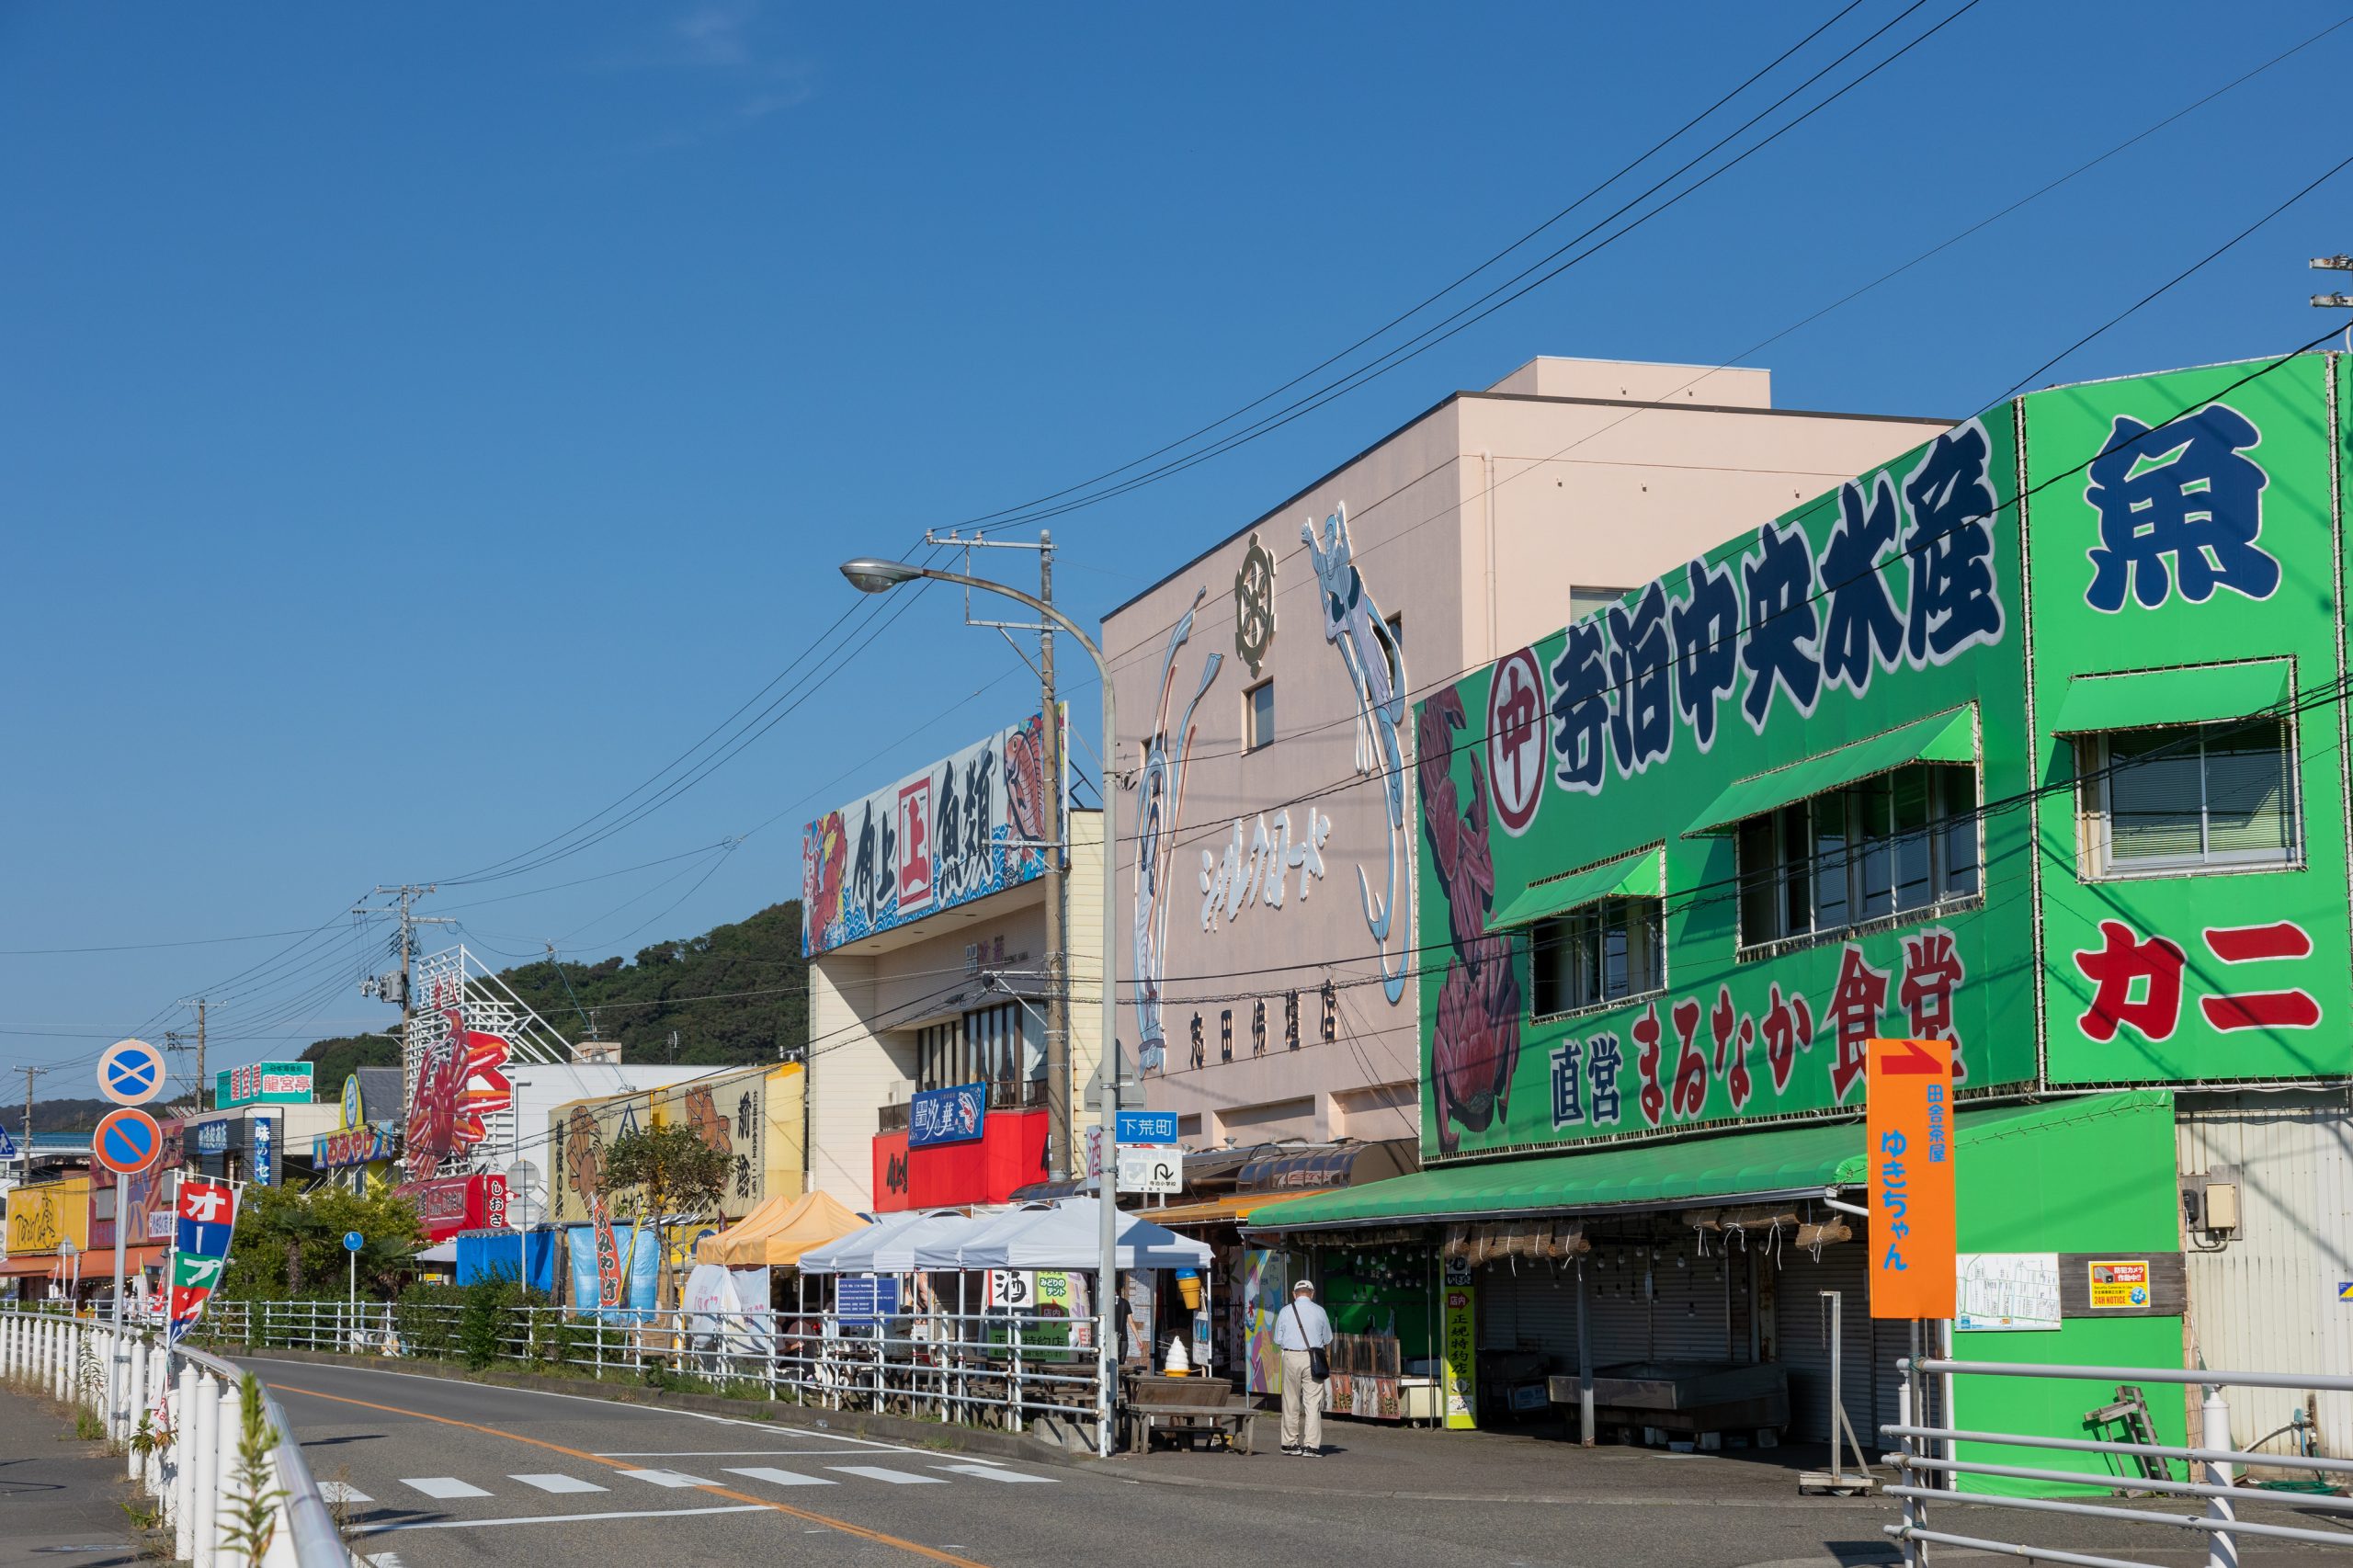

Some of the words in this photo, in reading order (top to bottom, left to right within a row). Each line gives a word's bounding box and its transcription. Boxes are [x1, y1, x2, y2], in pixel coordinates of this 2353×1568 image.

[2085, 402, 2281, 613] 魚
[1550, 418, 2006, 795] 寺泊中央水産
[2075, 921, 2322, 1044] カニ
[1550, 1033, 1623, 1131] 直営
[1632, 928, 1965, 1129] まるなか食堂
[263, 1074, 312, 1092] 龍宮亭
[1120, 1119, 1173, 1137] 下荒町
[1927, 1084, 1947, 1163] 田舎茶屋
[255, 1125, 270, 1186] 味のセ
[1881, 1130, 1910, 1272] ゆきちゃん
[597, 1201, 618, 1301] おみやげ
[1040, 1278, 1065, 1287] みどりの
[1043, 1308, 1061, 1317] 店内
[1046, 1288, 1066, 1296] テント
[1449, 1296, 1466, 1305] 店内
[2106, 1295, 2126, 1304] NOTICE
[995, 1335, 1065, 1347] 正特約店
[1450, 1314, 1470, 1374] 正規特約店
